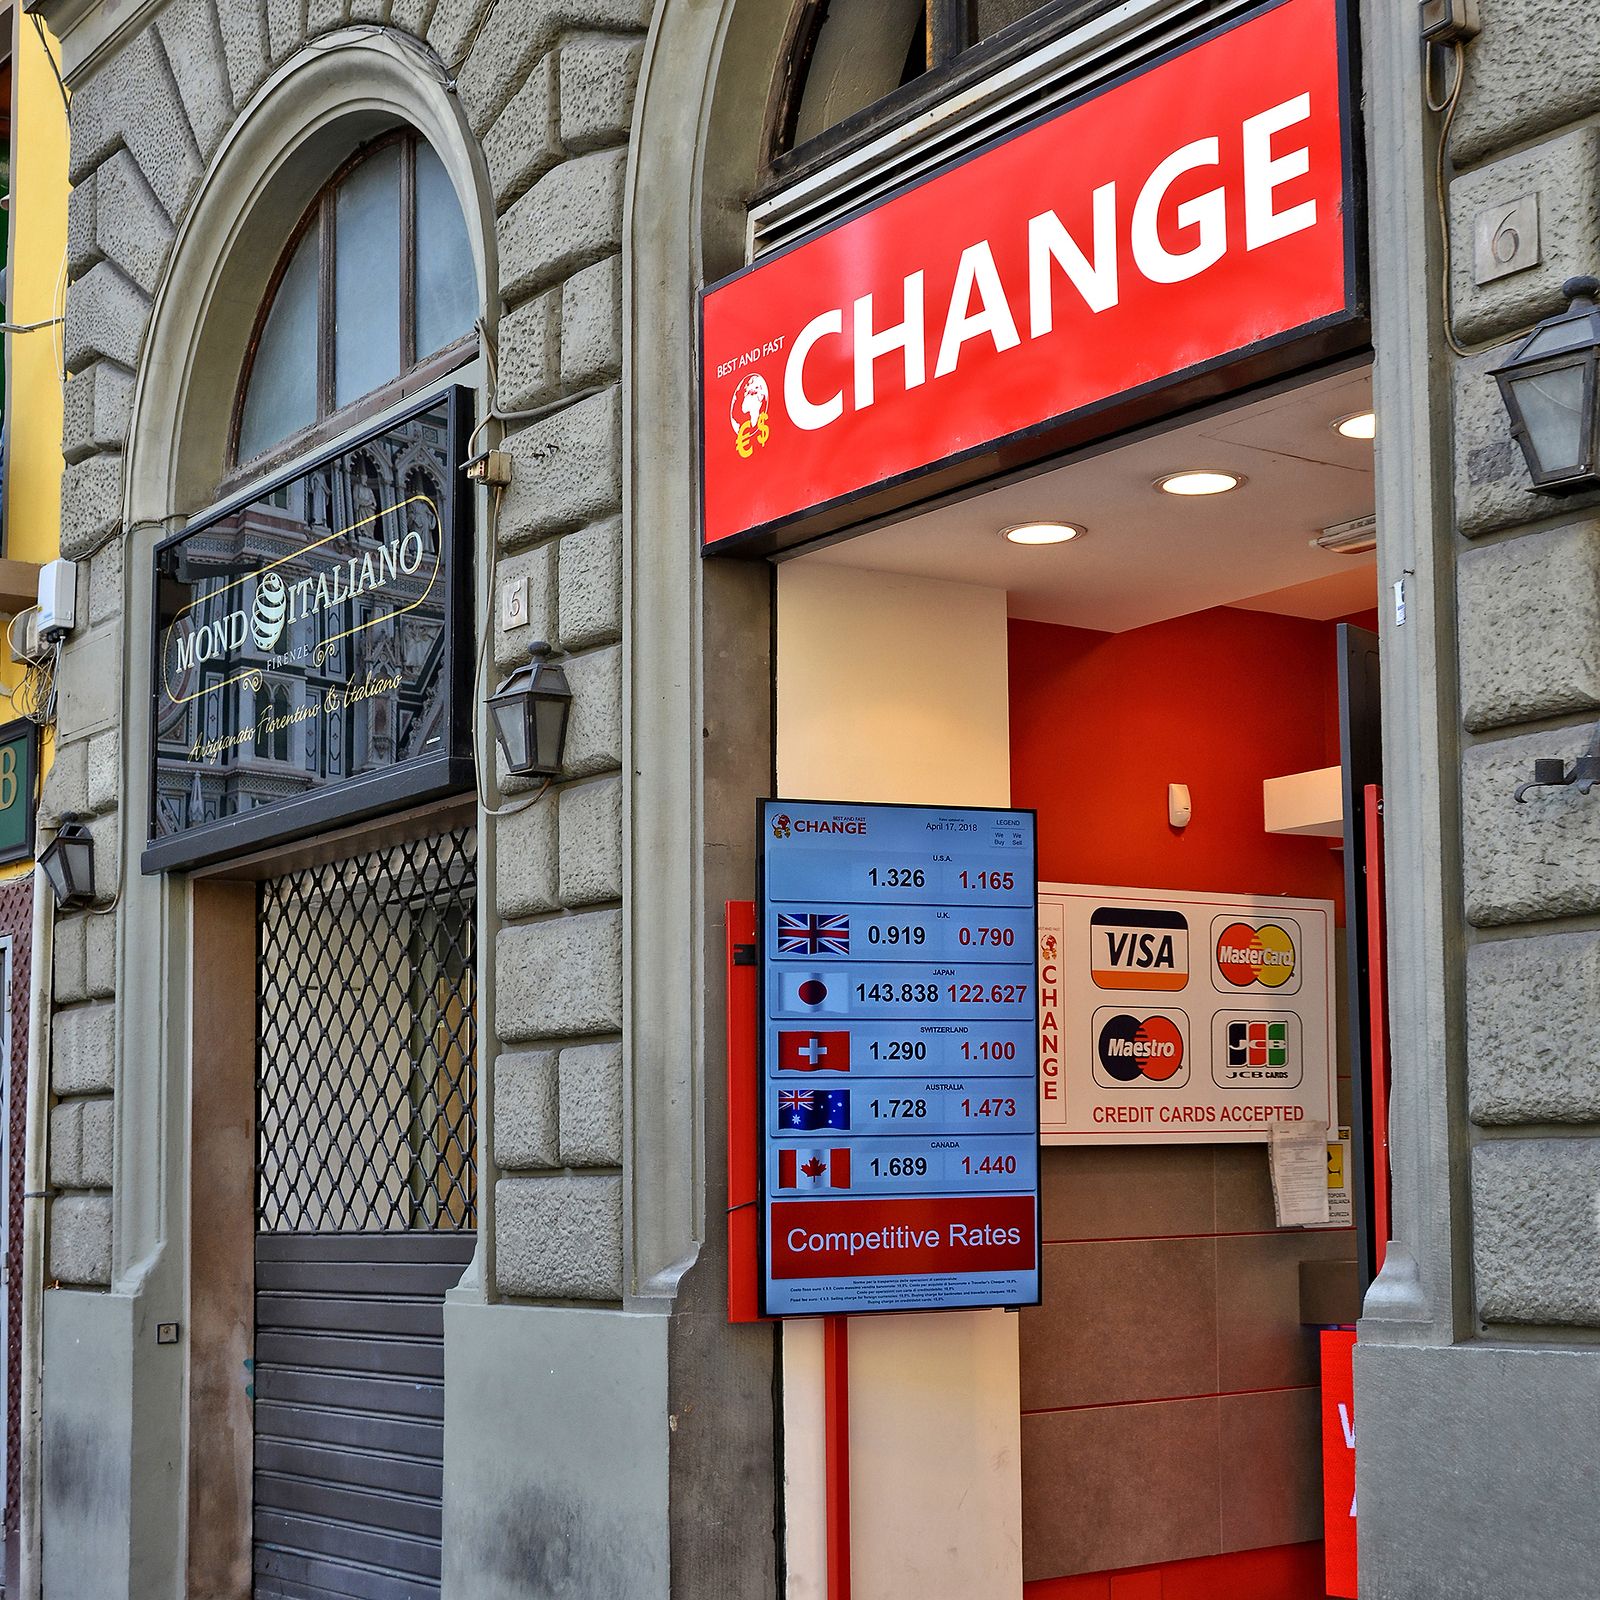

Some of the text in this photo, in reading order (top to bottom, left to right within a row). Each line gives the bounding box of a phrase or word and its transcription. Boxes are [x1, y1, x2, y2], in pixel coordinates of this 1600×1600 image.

[1491, 209, 1520, 264] 6
[783, 90, 1318, 432] CHANGE
[717, 336, 786, 378] BEST AND FAST
[286, 531, 423, 626] ITALIANO
[509, 586, 522, 618] 5
[266, 643, 310, 672] FIRENZE
[187, 670, 402, 766] Artigianato Fiorentino & Italiano
[794, 820, 867, 834] CHANGE
[926, 822, 978, 832] April 17, 2018
[868, 868, 1014, 890] 1.326 1.165
[868, 925, 1015, 946] 0.919 0.790
[1104, 932, 1175, 968] VISA
[1219, 946, 1295, 966] MasterCard
[856, 984, 1028, 1004] 143.838 122.627
[920, 1026, 969, 1034] SWITZERLAND
[1041, 966, 1058, 1100] CHANGE
[870, 1041, 1016, 1060] 1.290 1.100
[1107, 1038, 1174, 1057] Maestro
[1228, 1039, 1286, 1050] JCB
[870, 1098, 1016, 1118] 1.728 1.473
[1092, 1106, 1304, 1123] CREDIT CARDS ACCEPTED
[870, 1156, 1016, 1176] 1.689 1.440
[787, 1223, 1022, 1256] Competitive Rates
